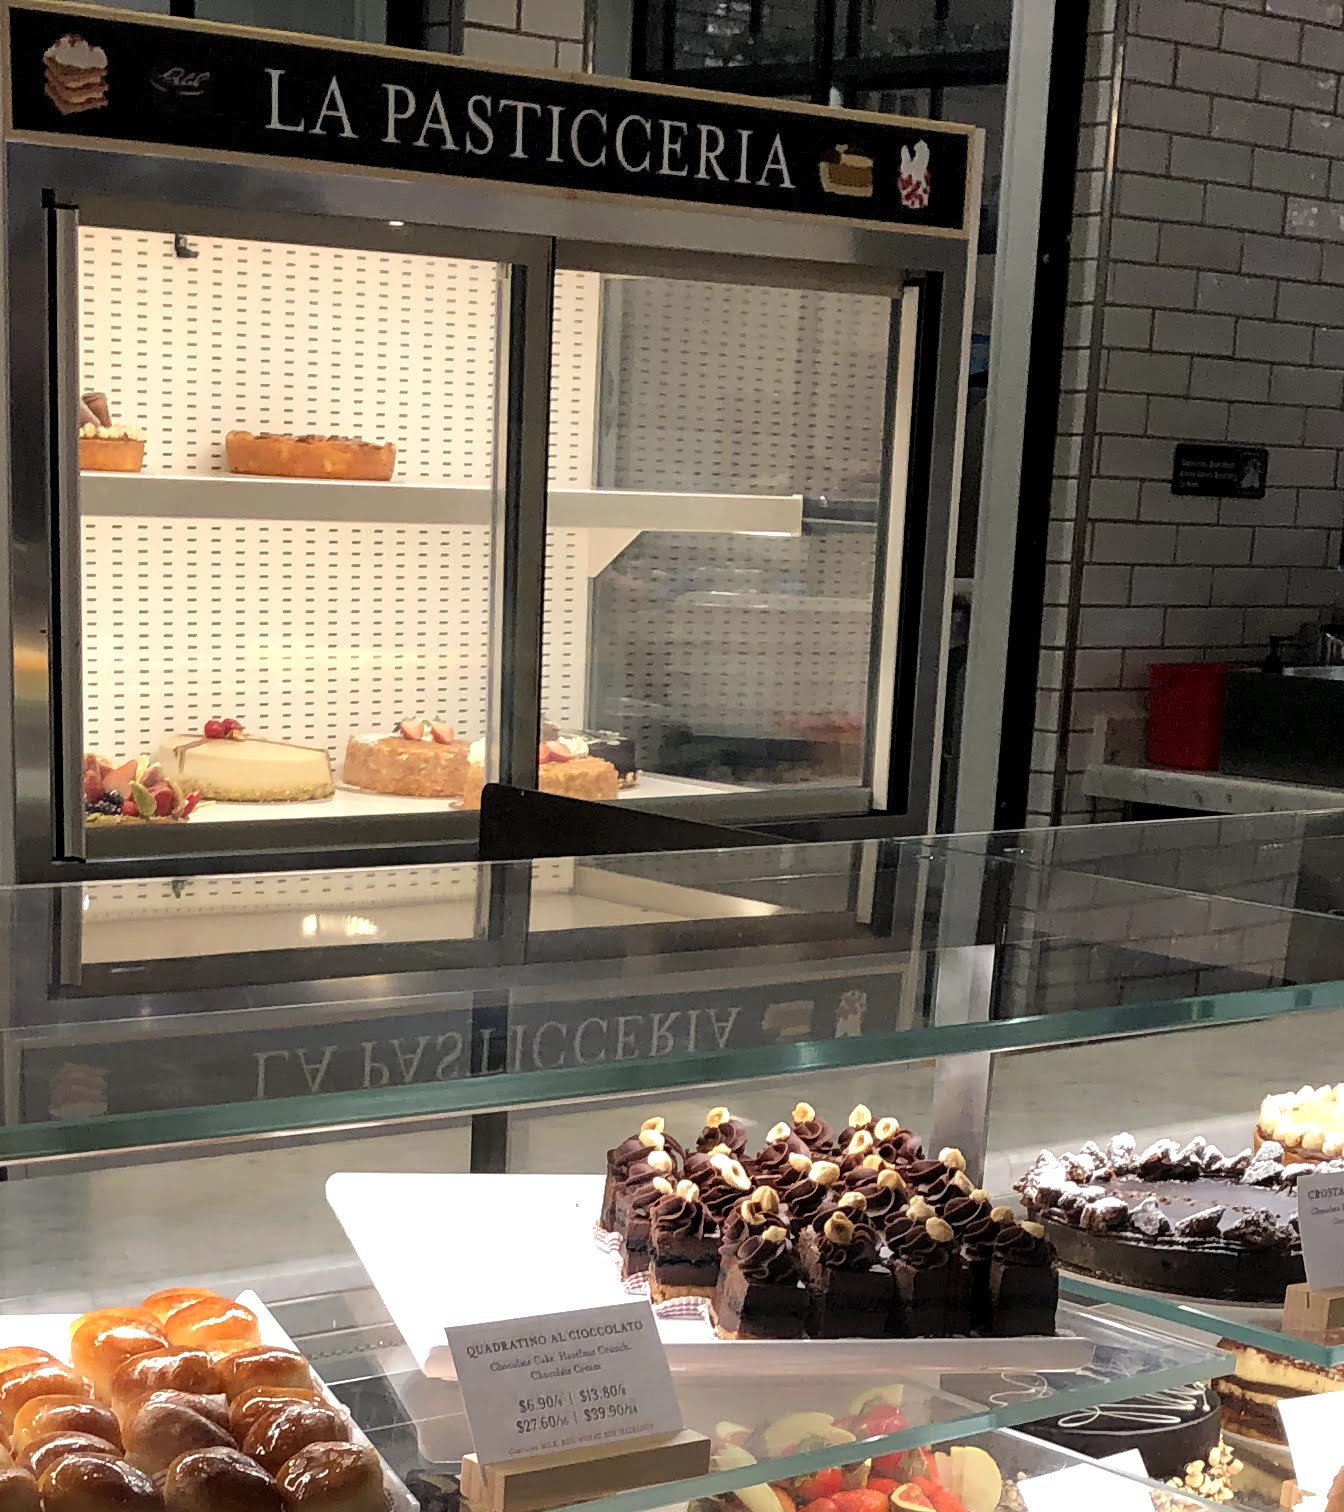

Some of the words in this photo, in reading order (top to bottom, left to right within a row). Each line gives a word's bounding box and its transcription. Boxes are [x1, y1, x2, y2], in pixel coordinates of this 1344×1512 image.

[264, 68, 359, 138] LA
[380, 82, 797, 189] PASTICCERIA
[466, 1335, 547, 1359] QUADRATINO
[550, 1331, 566, 1343] AL
[568, 1320, 644, 1340] CIOCCOLATO
